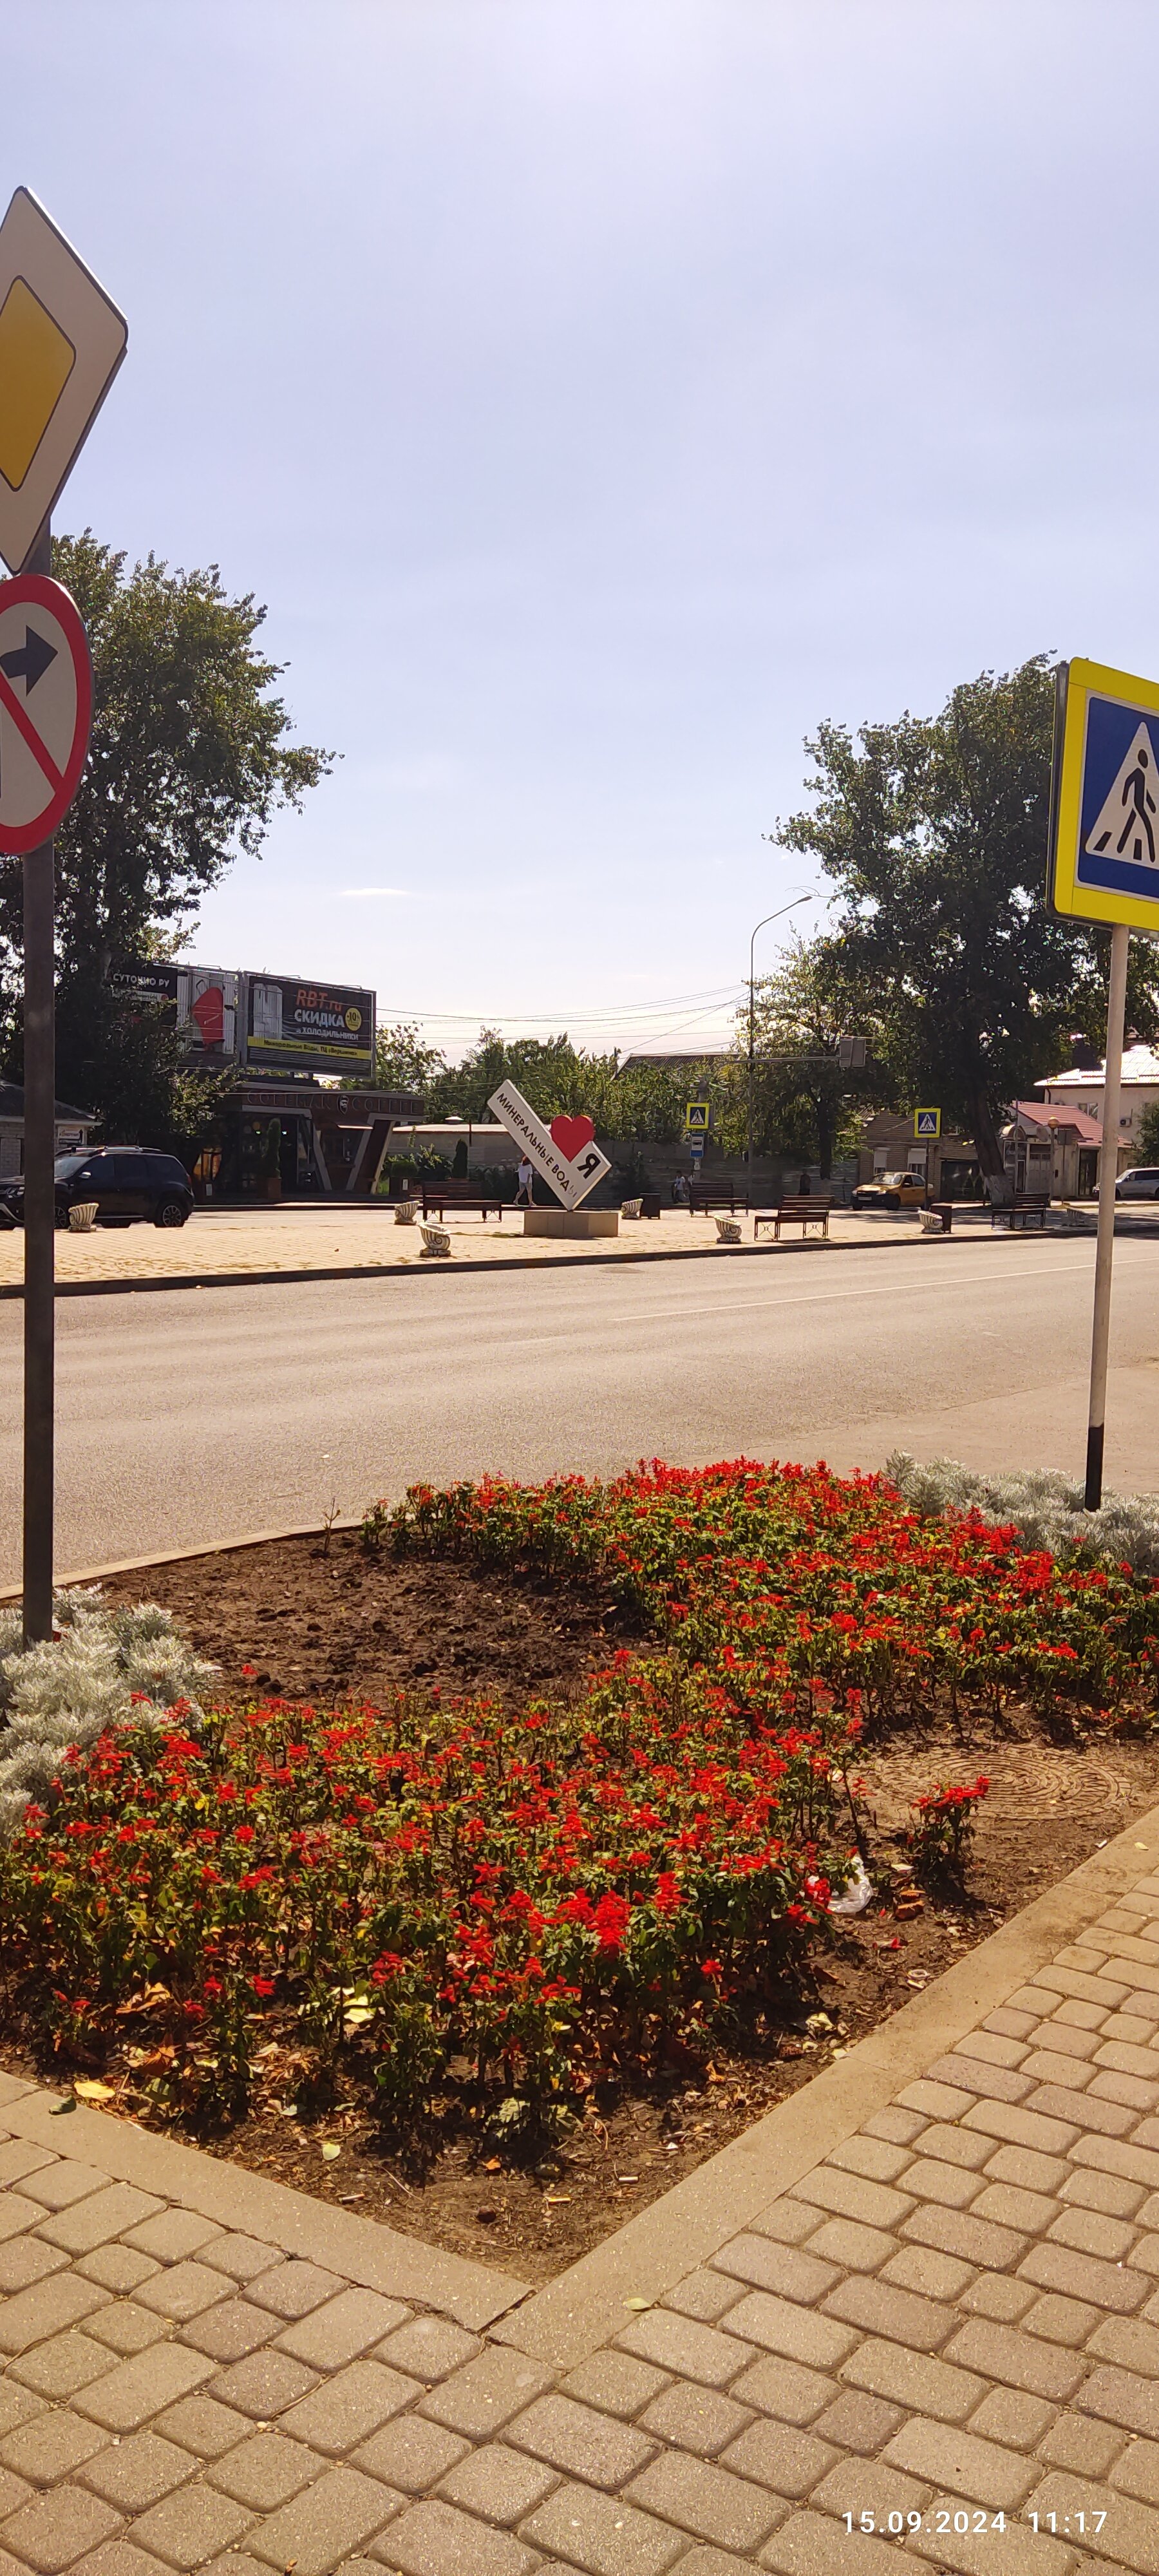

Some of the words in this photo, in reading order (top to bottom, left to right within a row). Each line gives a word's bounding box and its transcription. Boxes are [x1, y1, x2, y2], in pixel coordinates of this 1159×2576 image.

[158, 978, 170, 988] РУ
[296, 989, 343, 1012] RBT.ru
[294, 1009, 345, 1028] СКИДКА
[352, 1096, 419, 1114] COFFEE
[496, 1093, 554, 1167] МИНЕРАЛЬНЫЕ
[551, 1164, 578, 1198] ВОДЫ
[576, 1153, 601, 1179] Я
